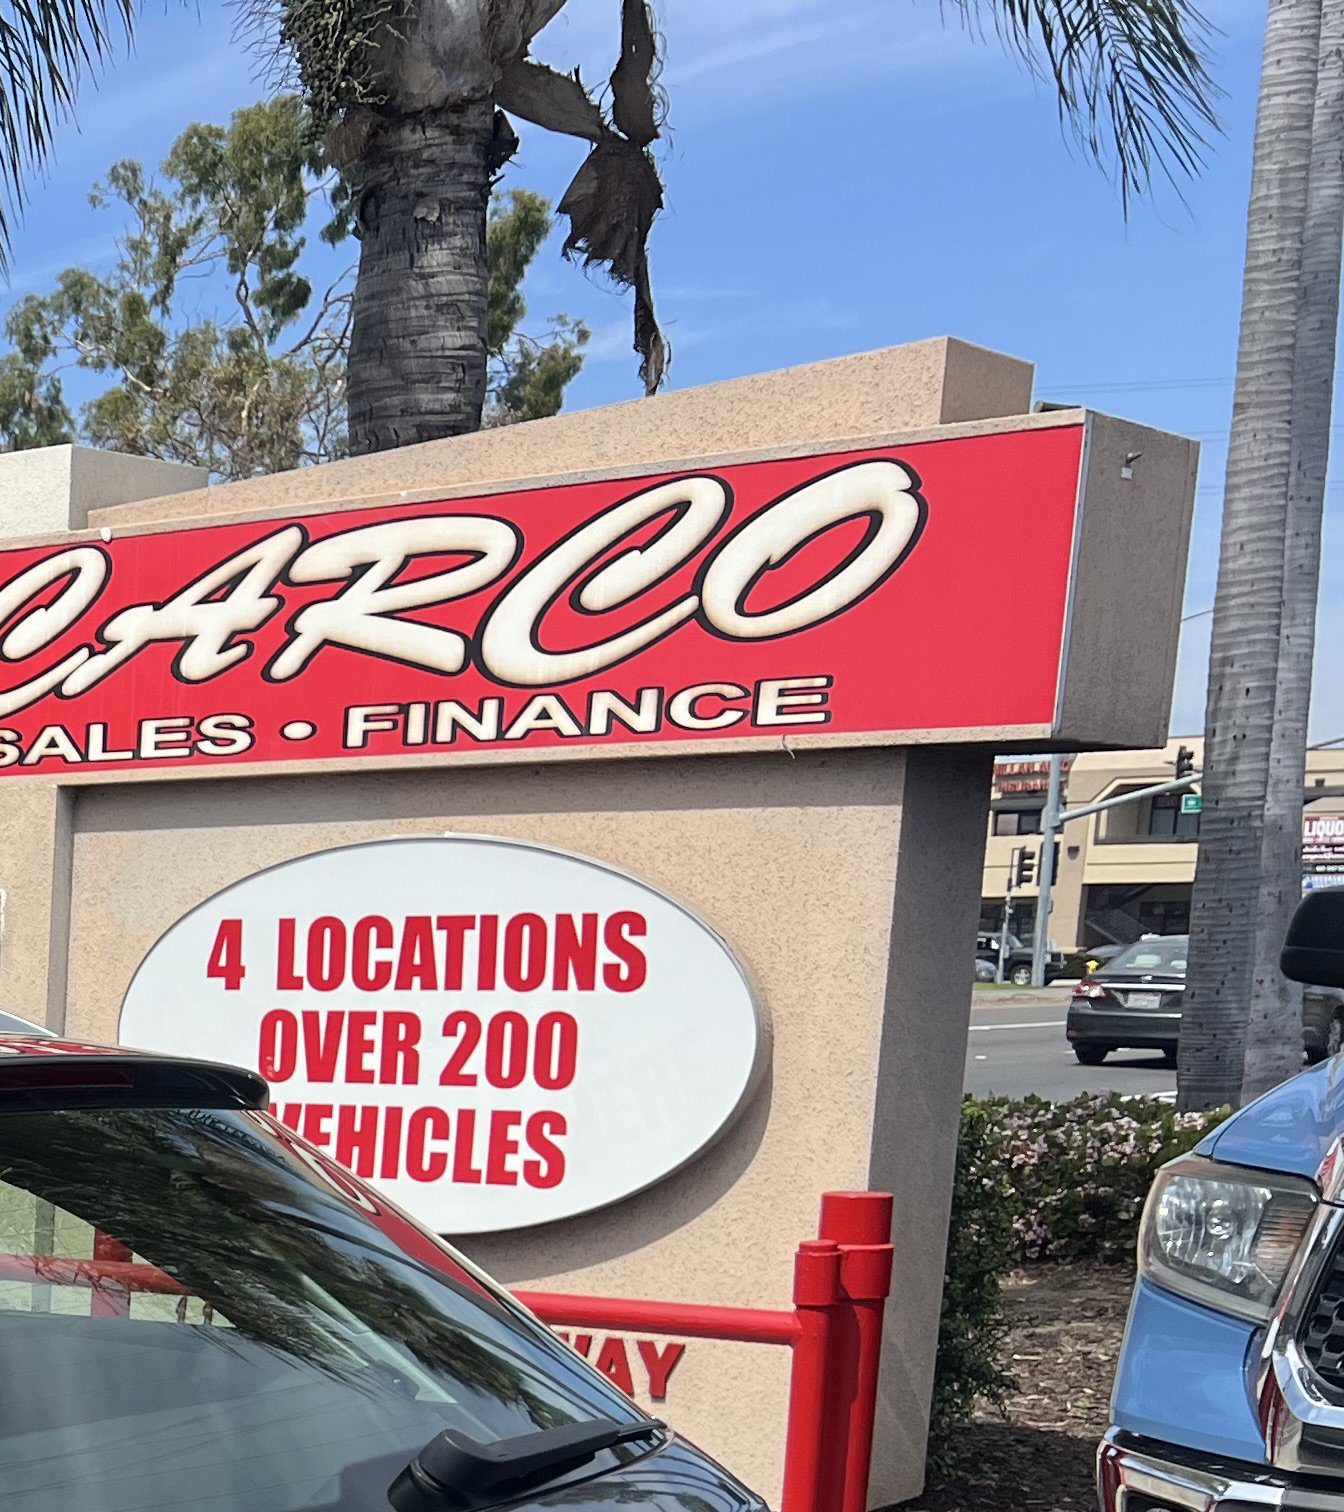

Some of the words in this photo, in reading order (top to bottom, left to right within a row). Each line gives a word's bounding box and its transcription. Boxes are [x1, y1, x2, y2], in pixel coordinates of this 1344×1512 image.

[342, 674, 835, 752] FINANCE
[206, 918, 246, 991] 4
[276, 910, 648, 993] LOCATIONS
[258, 1008, 420, 1085] OVER
[439, 1010, 578, 1090] 200
[558, 1332, 686, 1403] AY
